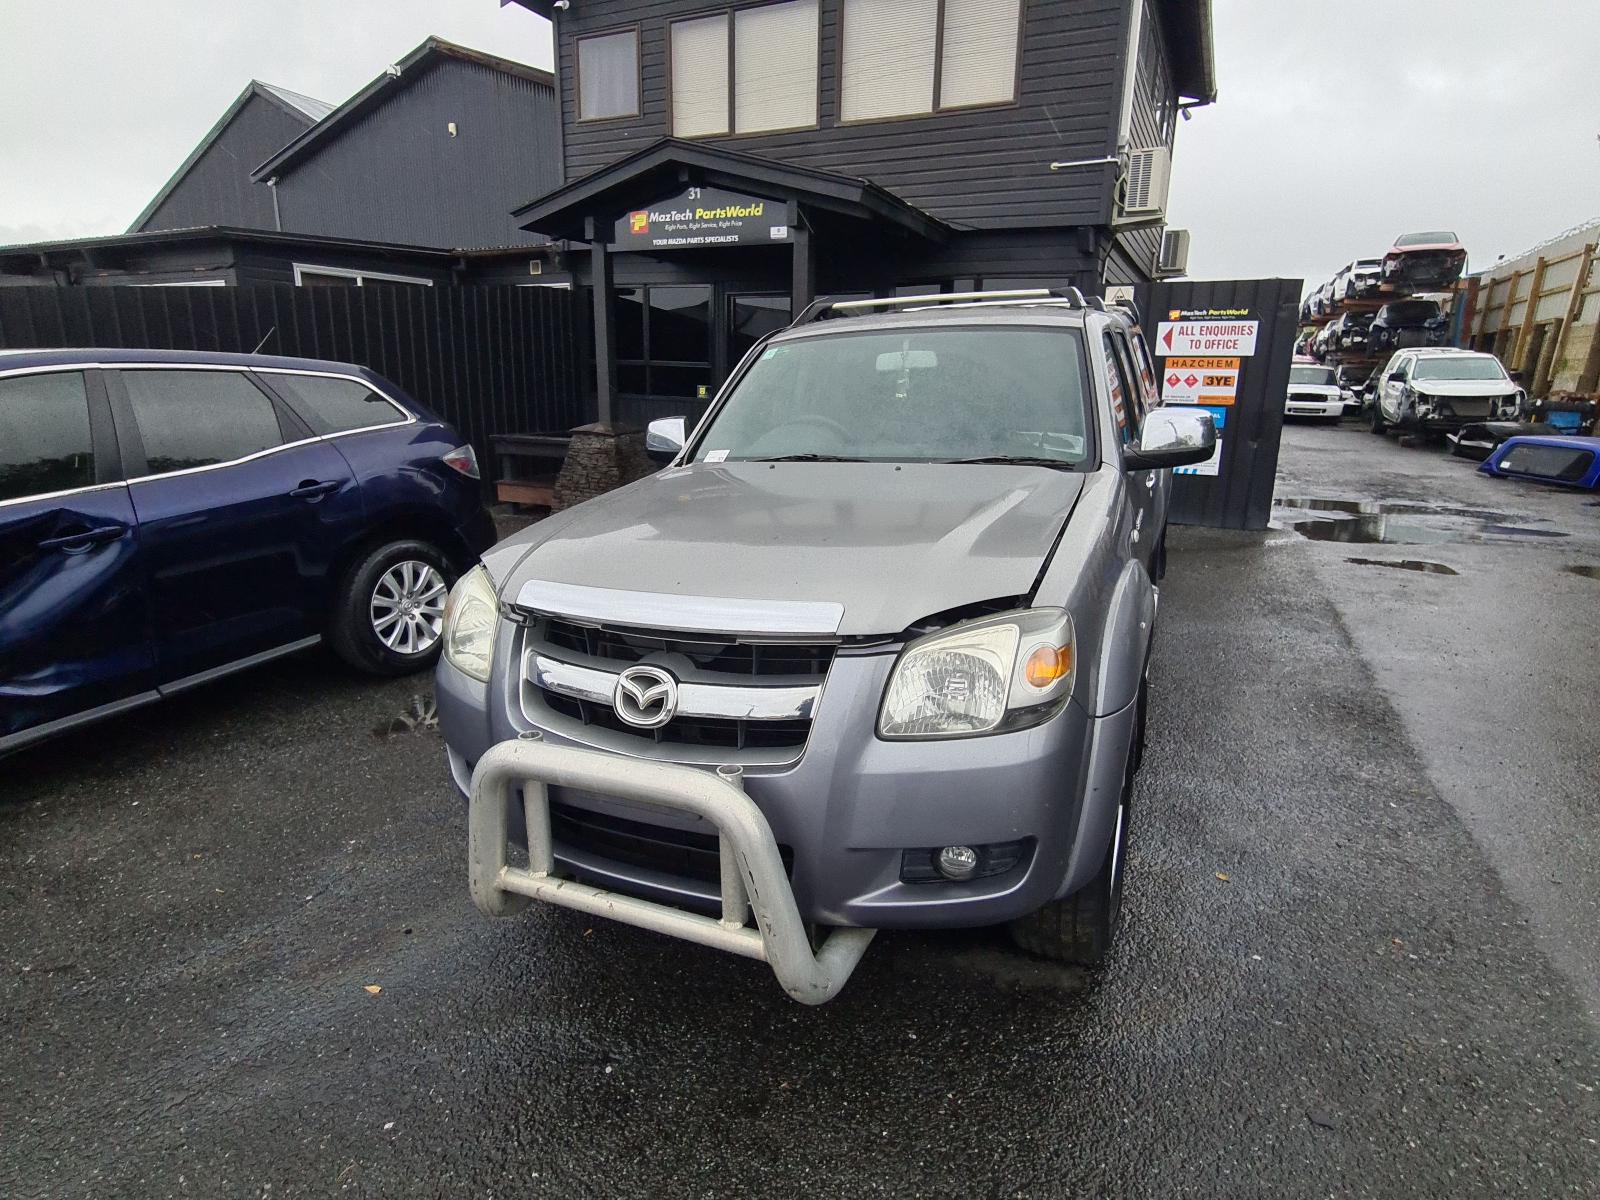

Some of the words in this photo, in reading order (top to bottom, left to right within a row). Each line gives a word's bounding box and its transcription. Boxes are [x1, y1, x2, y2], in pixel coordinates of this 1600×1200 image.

[688, 187, 701, 200] 31
[649, 208, 693, 222] MazTech
[695, 203, 764, 220] PartsWorld
[687, 236, 705, 244] PARTS
[705, 235, 739, 243] SPECIALISTS
[1208, 308, 1249, 316] PartsWorld
[1178, 326, 1196, 336] ALL
[1199, 325, 1254, 337] ENQUIRIES
[1189, 339, 1201, 350] TO
[1204, 338, 1239, 350] OFFICE
[1171, 359, 1233, 368] HAZCHEM
[1205, 376, 1232, 386] 3YE
